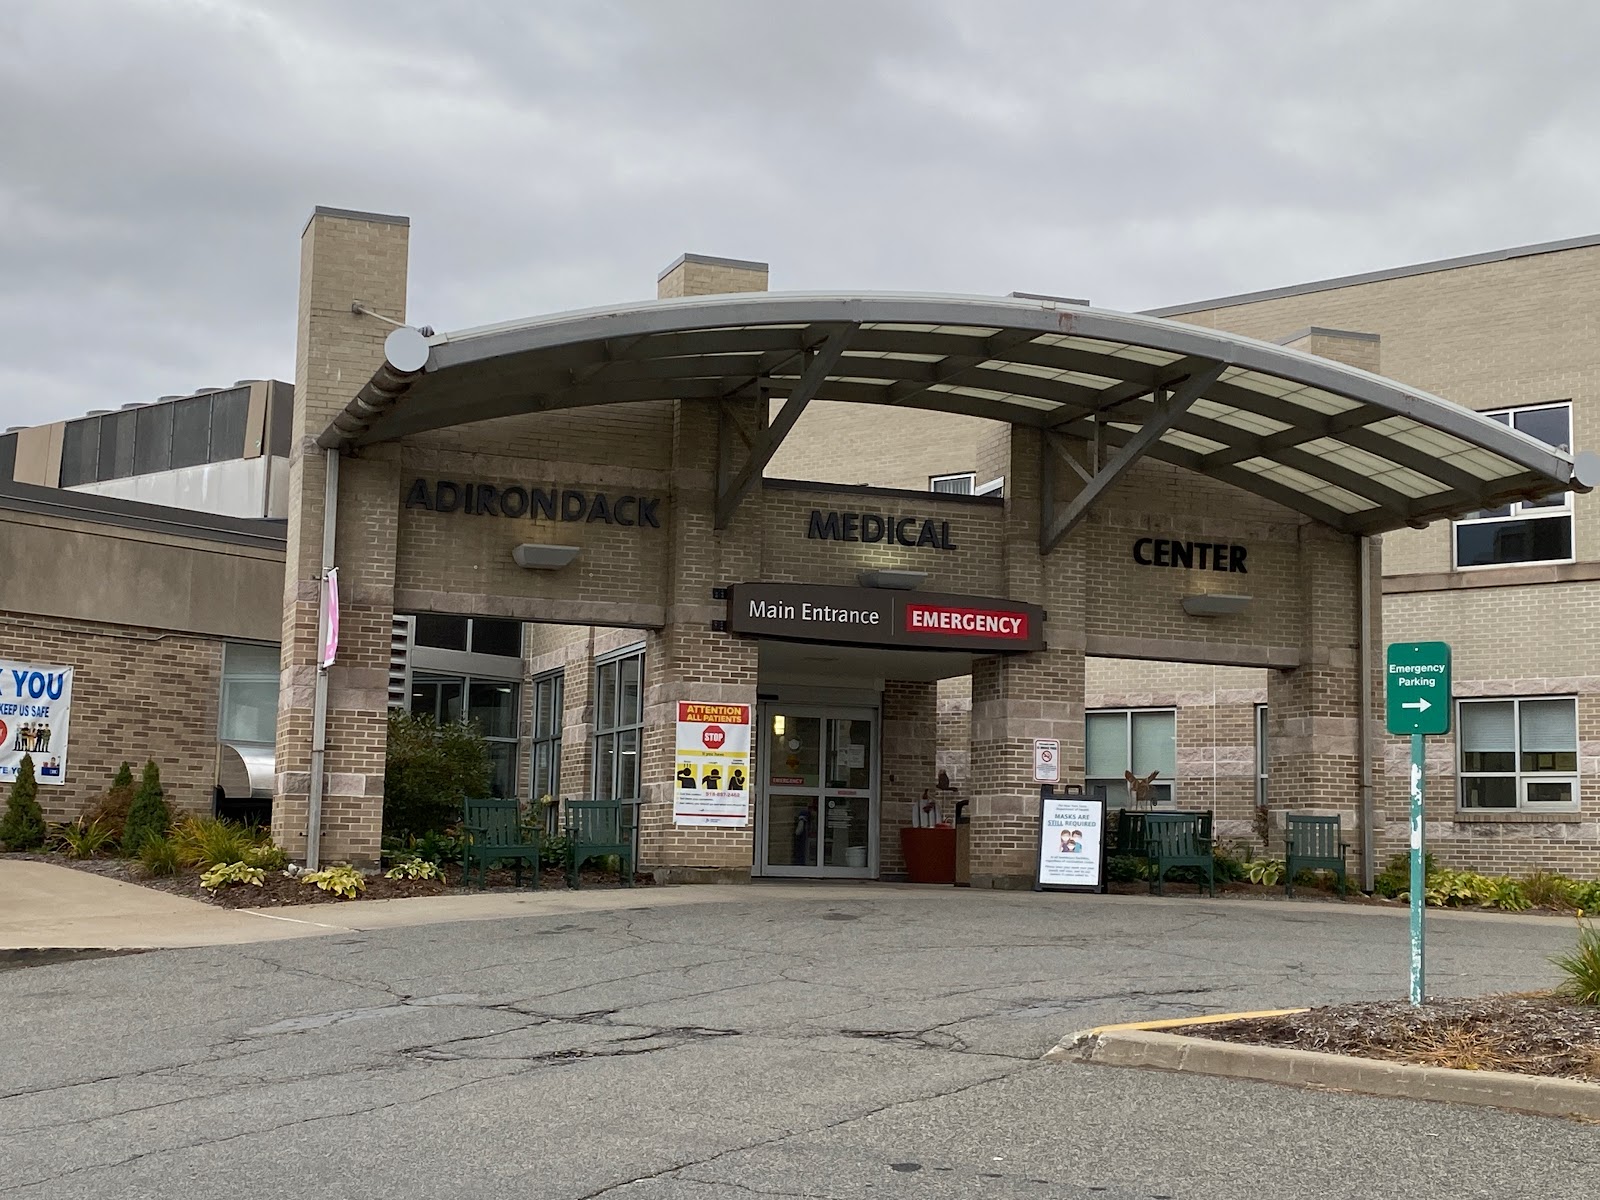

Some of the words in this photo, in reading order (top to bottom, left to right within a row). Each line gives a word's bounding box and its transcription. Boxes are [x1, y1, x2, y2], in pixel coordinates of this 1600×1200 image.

[405, 479, 661, 528] ADIRONDACK
[808, 510, 957, 550] MEDICAL
[1133, 538, 1248, 573] CENTER
[749, 600, 795, 619] Main
[801, 603, 880, 625] Entrance
[912, 610, 1021, 634] EMERGENCY
[1389, 664, 1445, 674] Emergency
[11, 669, 64, 700] YOU
[1398, 677, 1436, 687] Parking
[19, 705, 29, 717] US
[32, 706, 49, 718] SAFE
[687, 704, 742, 715] ATTENTION
[686, 714, 702, 722] ALL
[703, 715, 742, 723] PATIENTS
[704, 732, 724, 742] STOP
[1064, 820, 1097, 828] REQUIRED
